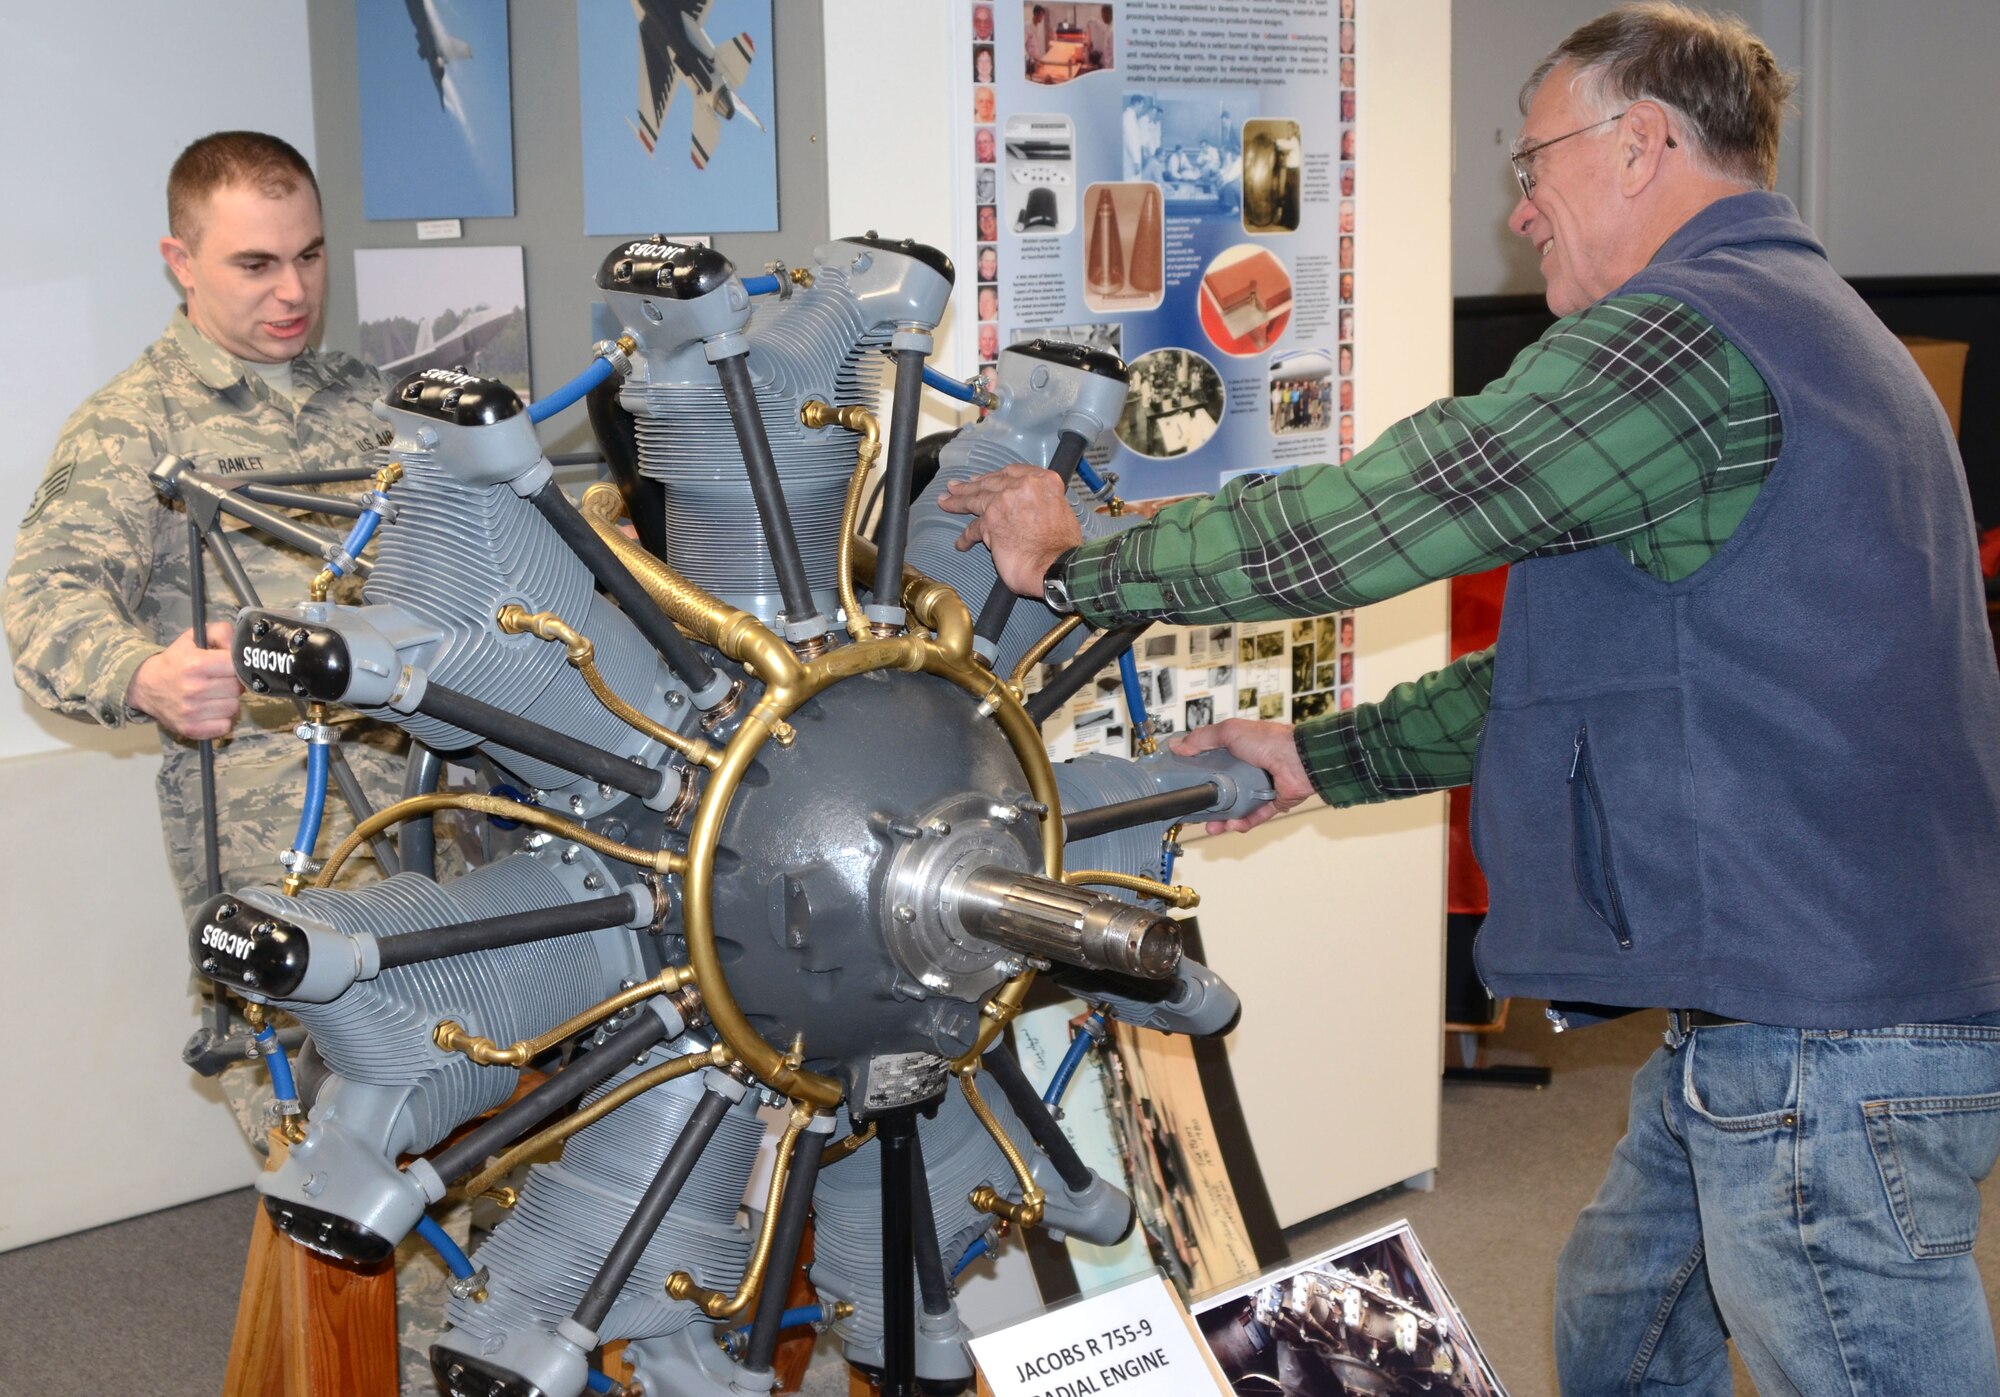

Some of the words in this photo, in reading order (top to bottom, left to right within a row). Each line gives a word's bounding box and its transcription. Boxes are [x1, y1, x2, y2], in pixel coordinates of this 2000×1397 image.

[624, 242, 686, 260] JACOBS
[420, 368, 480, 386] JACOBS
[355, 438, 378, 452] U.S.
[376, 430, 394, 446] AIR
[218, 456, 263, 474] RANLET
[244, 646, 295, 674] JACOBS
[201, 924, 255, 960] JACOBS
[1016, 1344, 1085, 1383] JACOBS
[1086, 1338, 1102, 1356] R
[1101, 1319, 1153, 1350] 755-9
[1100, 1348, 1170, 1388] ENGINE
